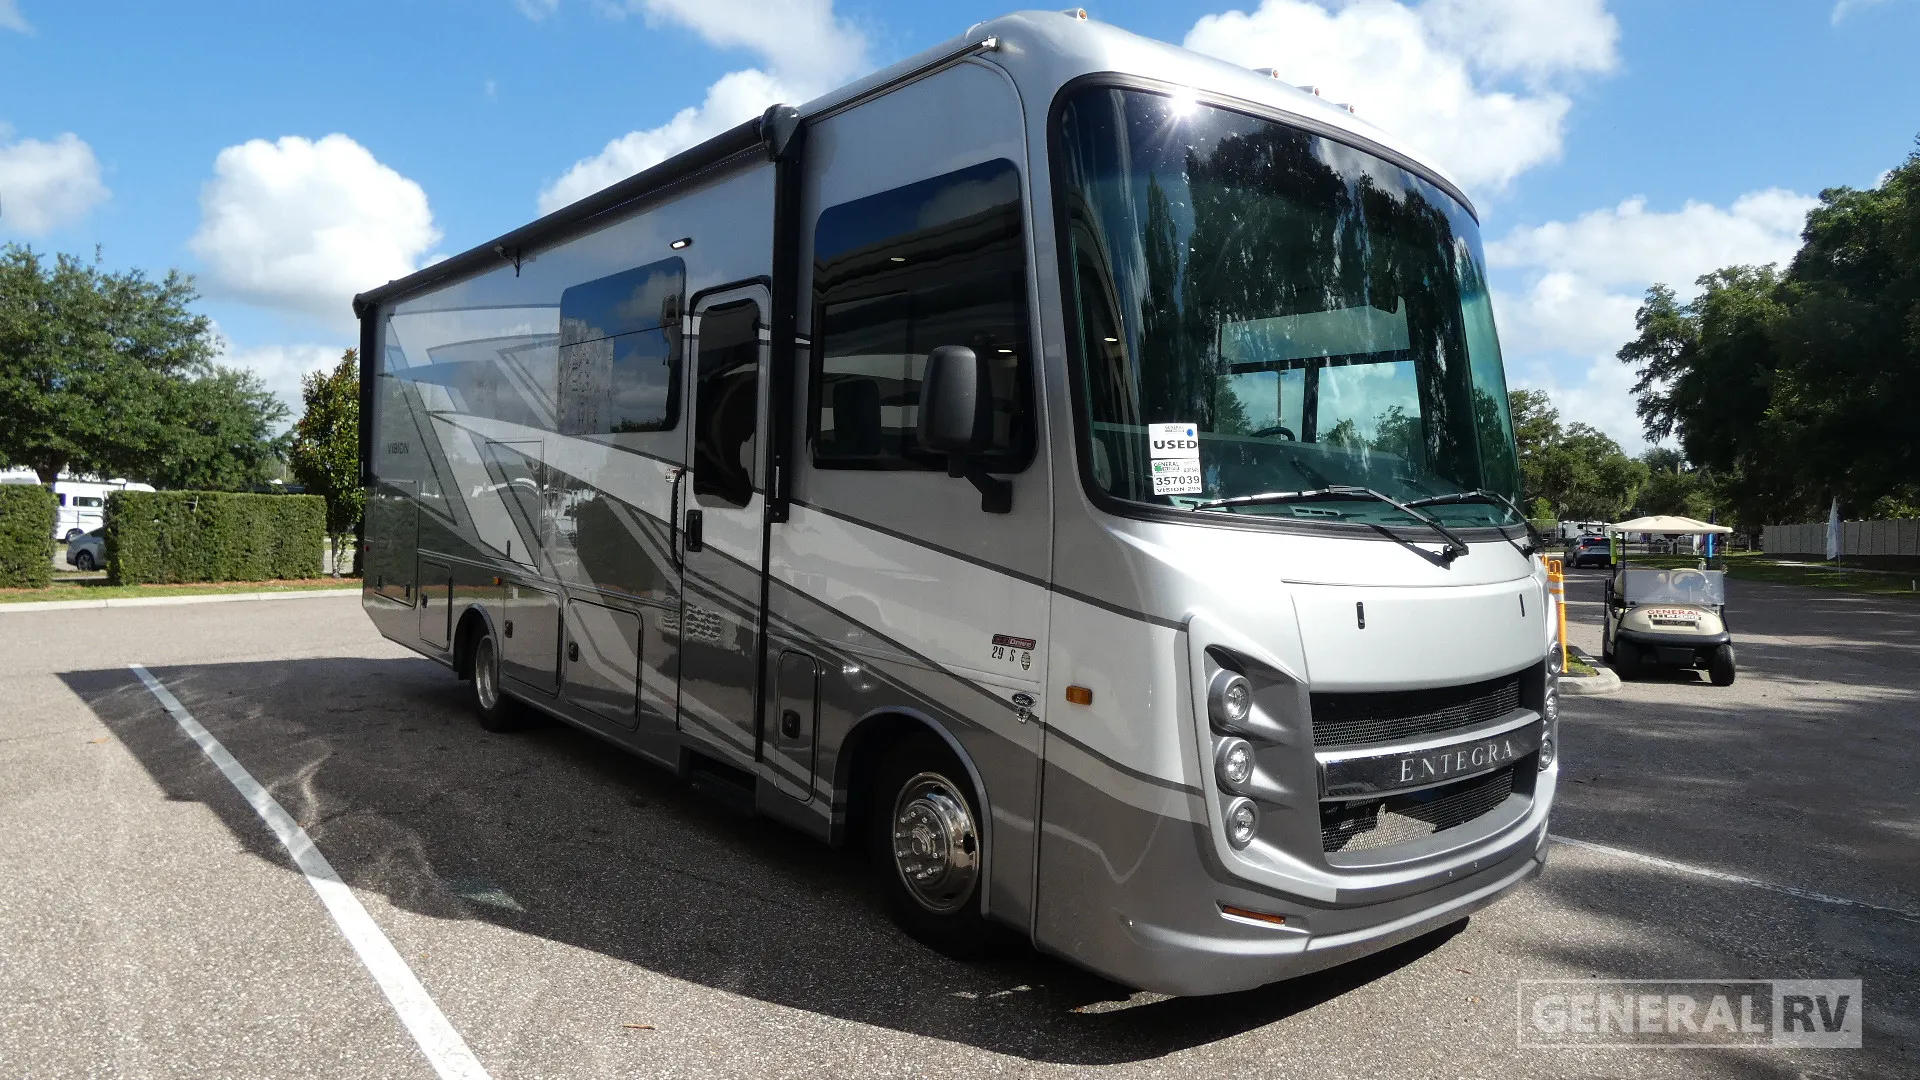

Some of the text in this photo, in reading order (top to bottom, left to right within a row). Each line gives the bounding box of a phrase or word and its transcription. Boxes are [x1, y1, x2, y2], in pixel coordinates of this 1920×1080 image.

[387, 442, 410, 455] VISION
[1153, 440, 1198, 450] USED
[1156, 475, 1200, 486] 357039
[1647, 608, 1701, 617] GENERAL
[1009, 638, 1032, 648] Drive
[992, 645, 1004, 660] 29
[1009, 648, 1016, 662] S
[1400, 740, 1513, 782] ENTEGRA
